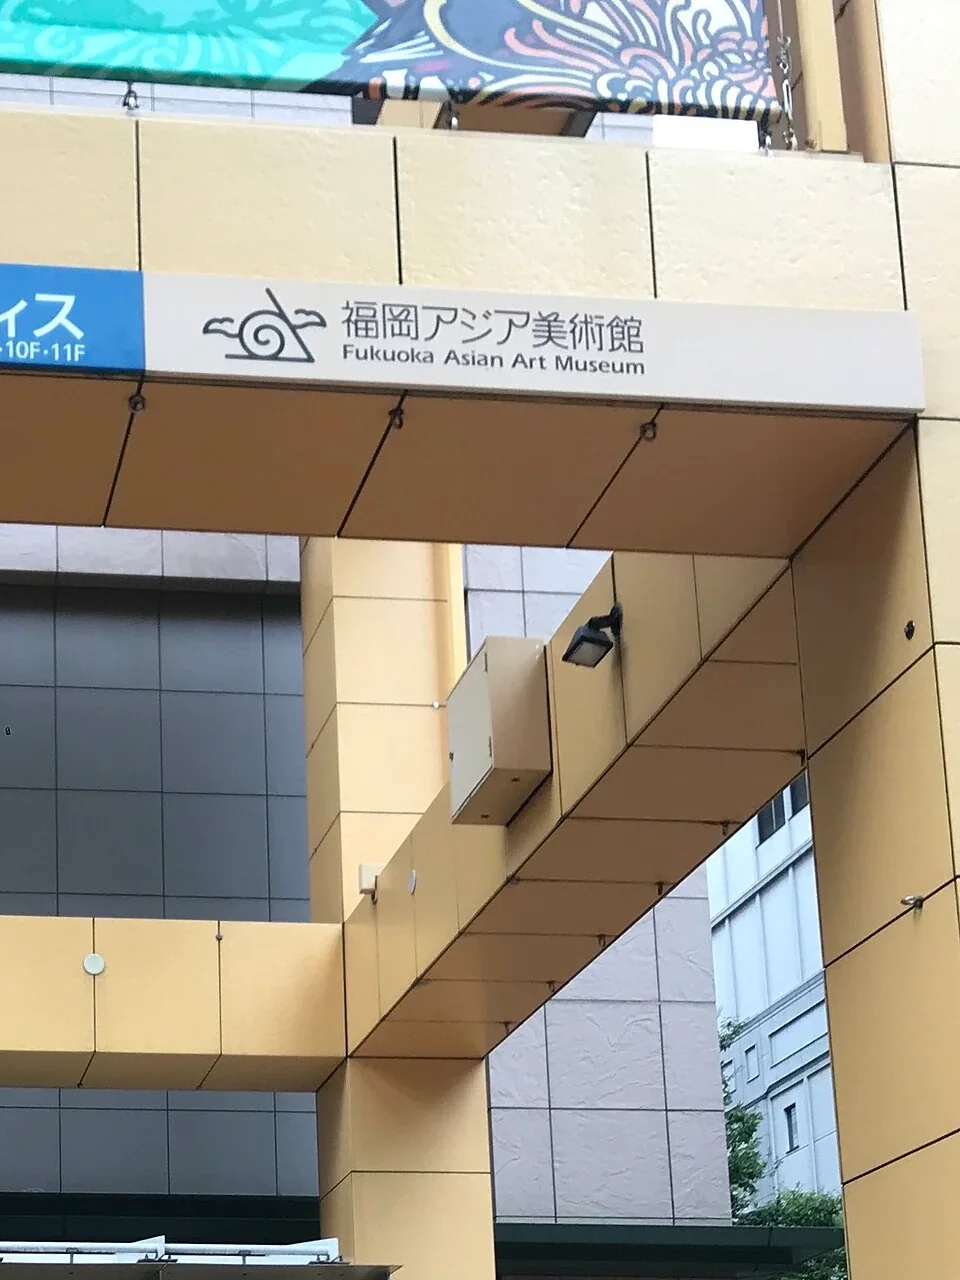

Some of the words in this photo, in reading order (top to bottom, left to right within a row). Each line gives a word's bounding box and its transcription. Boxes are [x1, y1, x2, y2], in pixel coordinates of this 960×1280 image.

[341, 300, 645, 354] 福岡アジア美術館
[342, 344, 435, 364] Fukuoka
[443, 349, 504, 368] Asian
[511, 353, 547, 371] Art
[555, 355, 645, 375] Museum
